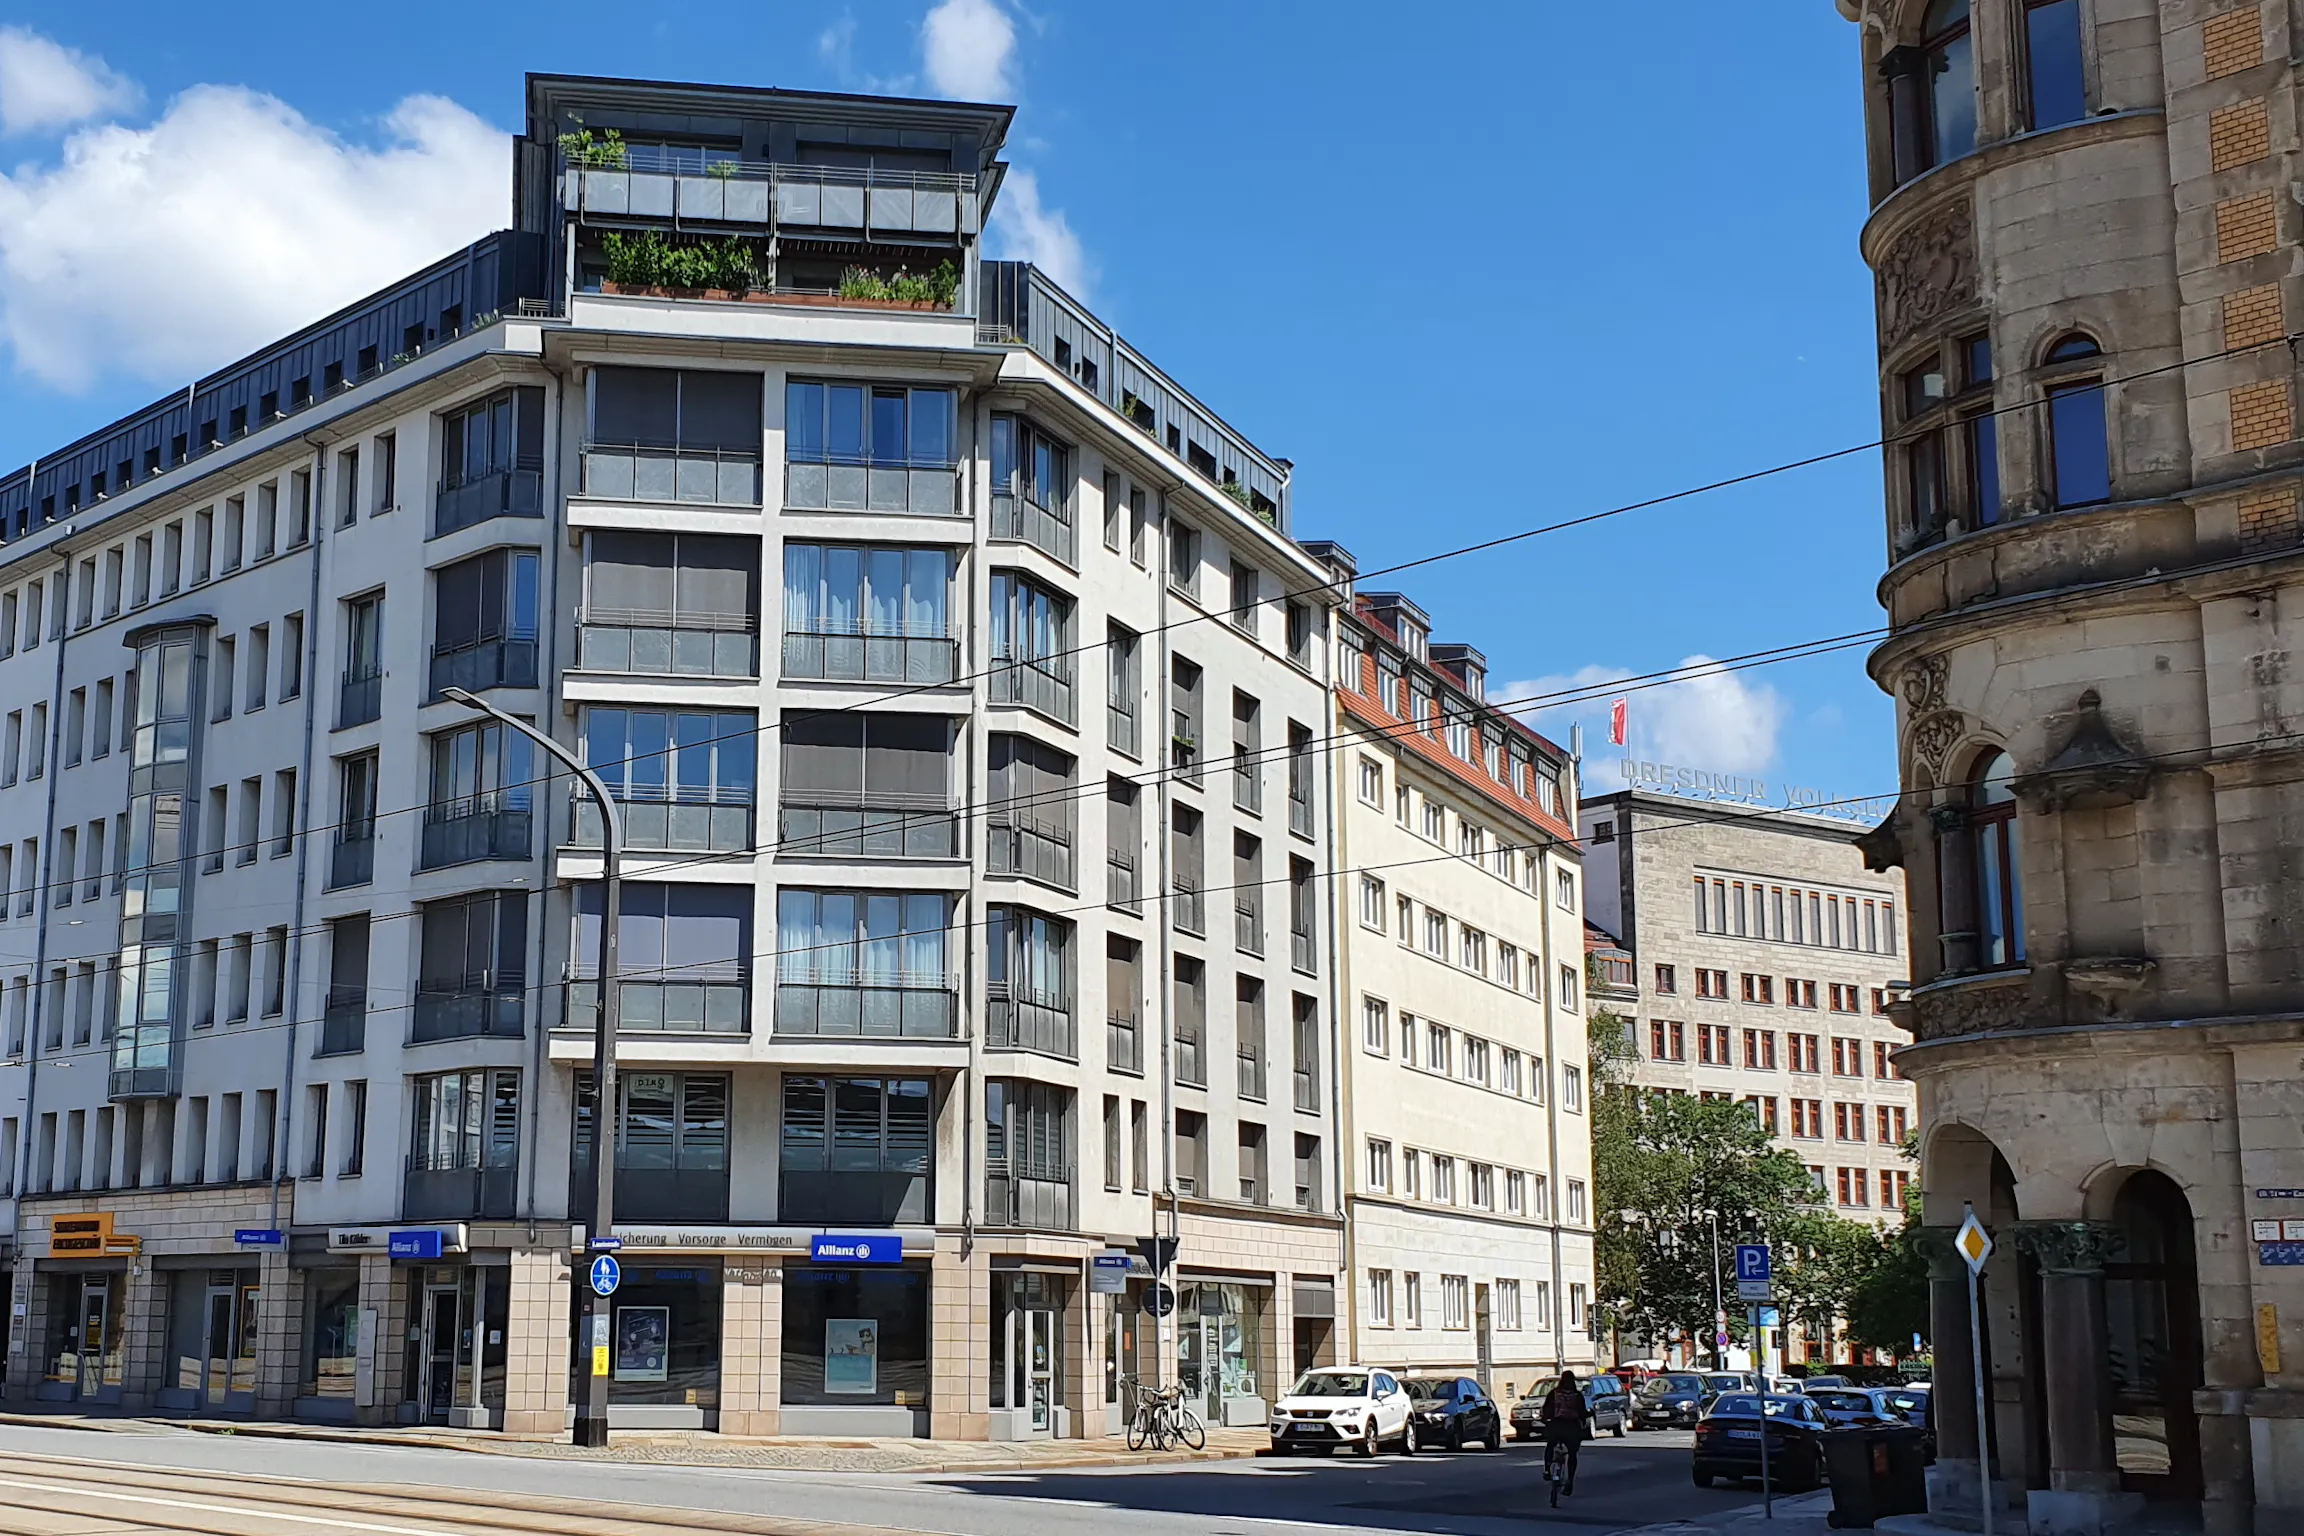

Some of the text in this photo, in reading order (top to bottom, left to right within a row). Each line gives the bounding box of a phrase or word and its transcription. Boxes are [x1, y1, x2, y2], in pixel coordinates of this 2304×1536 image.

[1621, 759, 1766, 799] DRESDNER
[678, 1233, 726, 1246] Vorsorge
[738, 1233, 792, 1246] Vermögen
[391, 1242, 412, 1252] Allianz
[817, 1244, 855, 1256] Allianz
[1743, 1249, 1762, 1276] P
